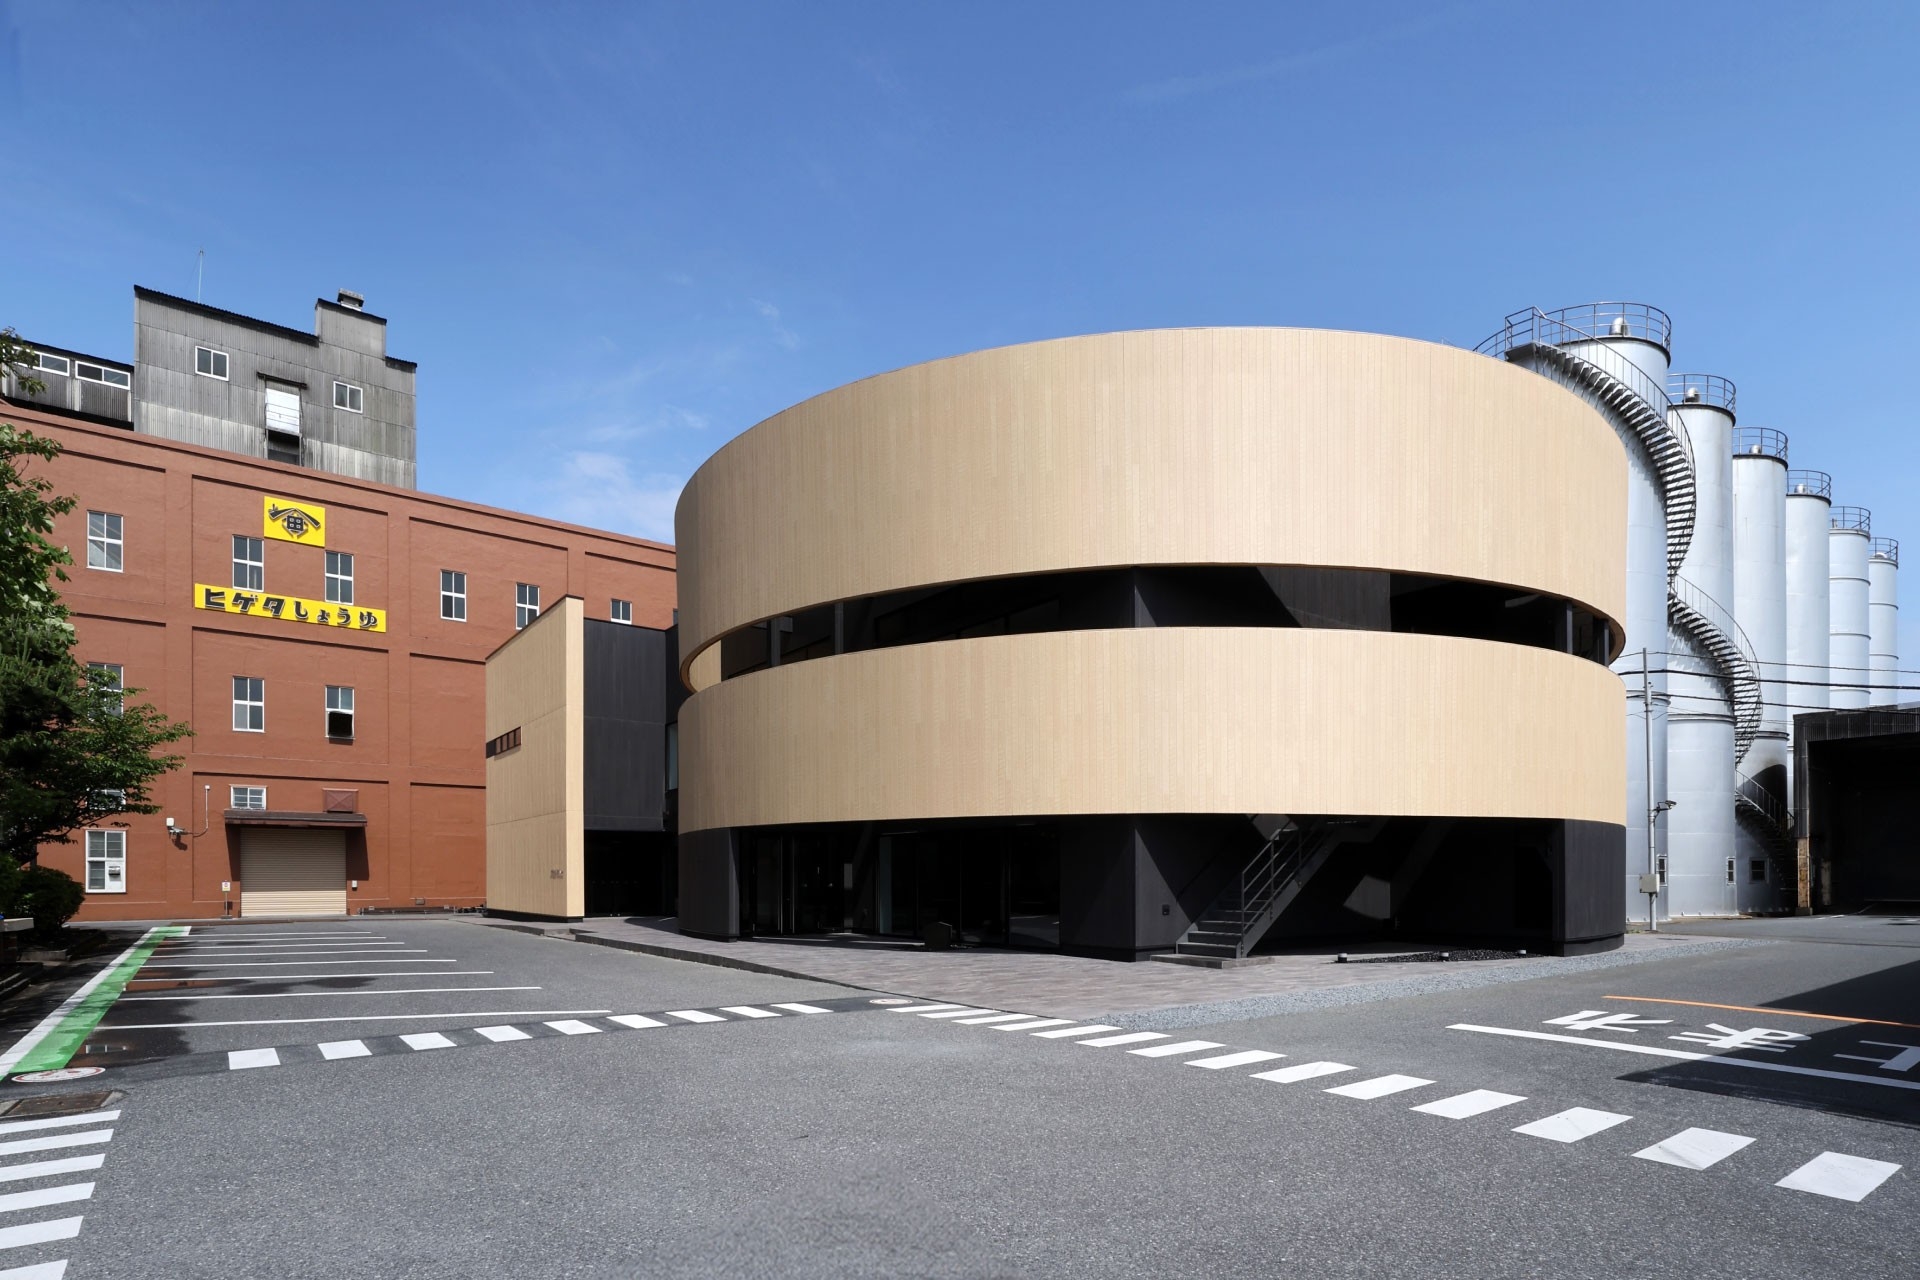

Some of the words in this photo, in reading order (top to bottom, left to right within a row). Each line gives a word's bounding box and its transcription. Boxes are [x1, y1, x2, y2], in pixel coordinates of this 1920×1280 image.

[204, 588, 378, 628] ヒゲタしょうゆ
